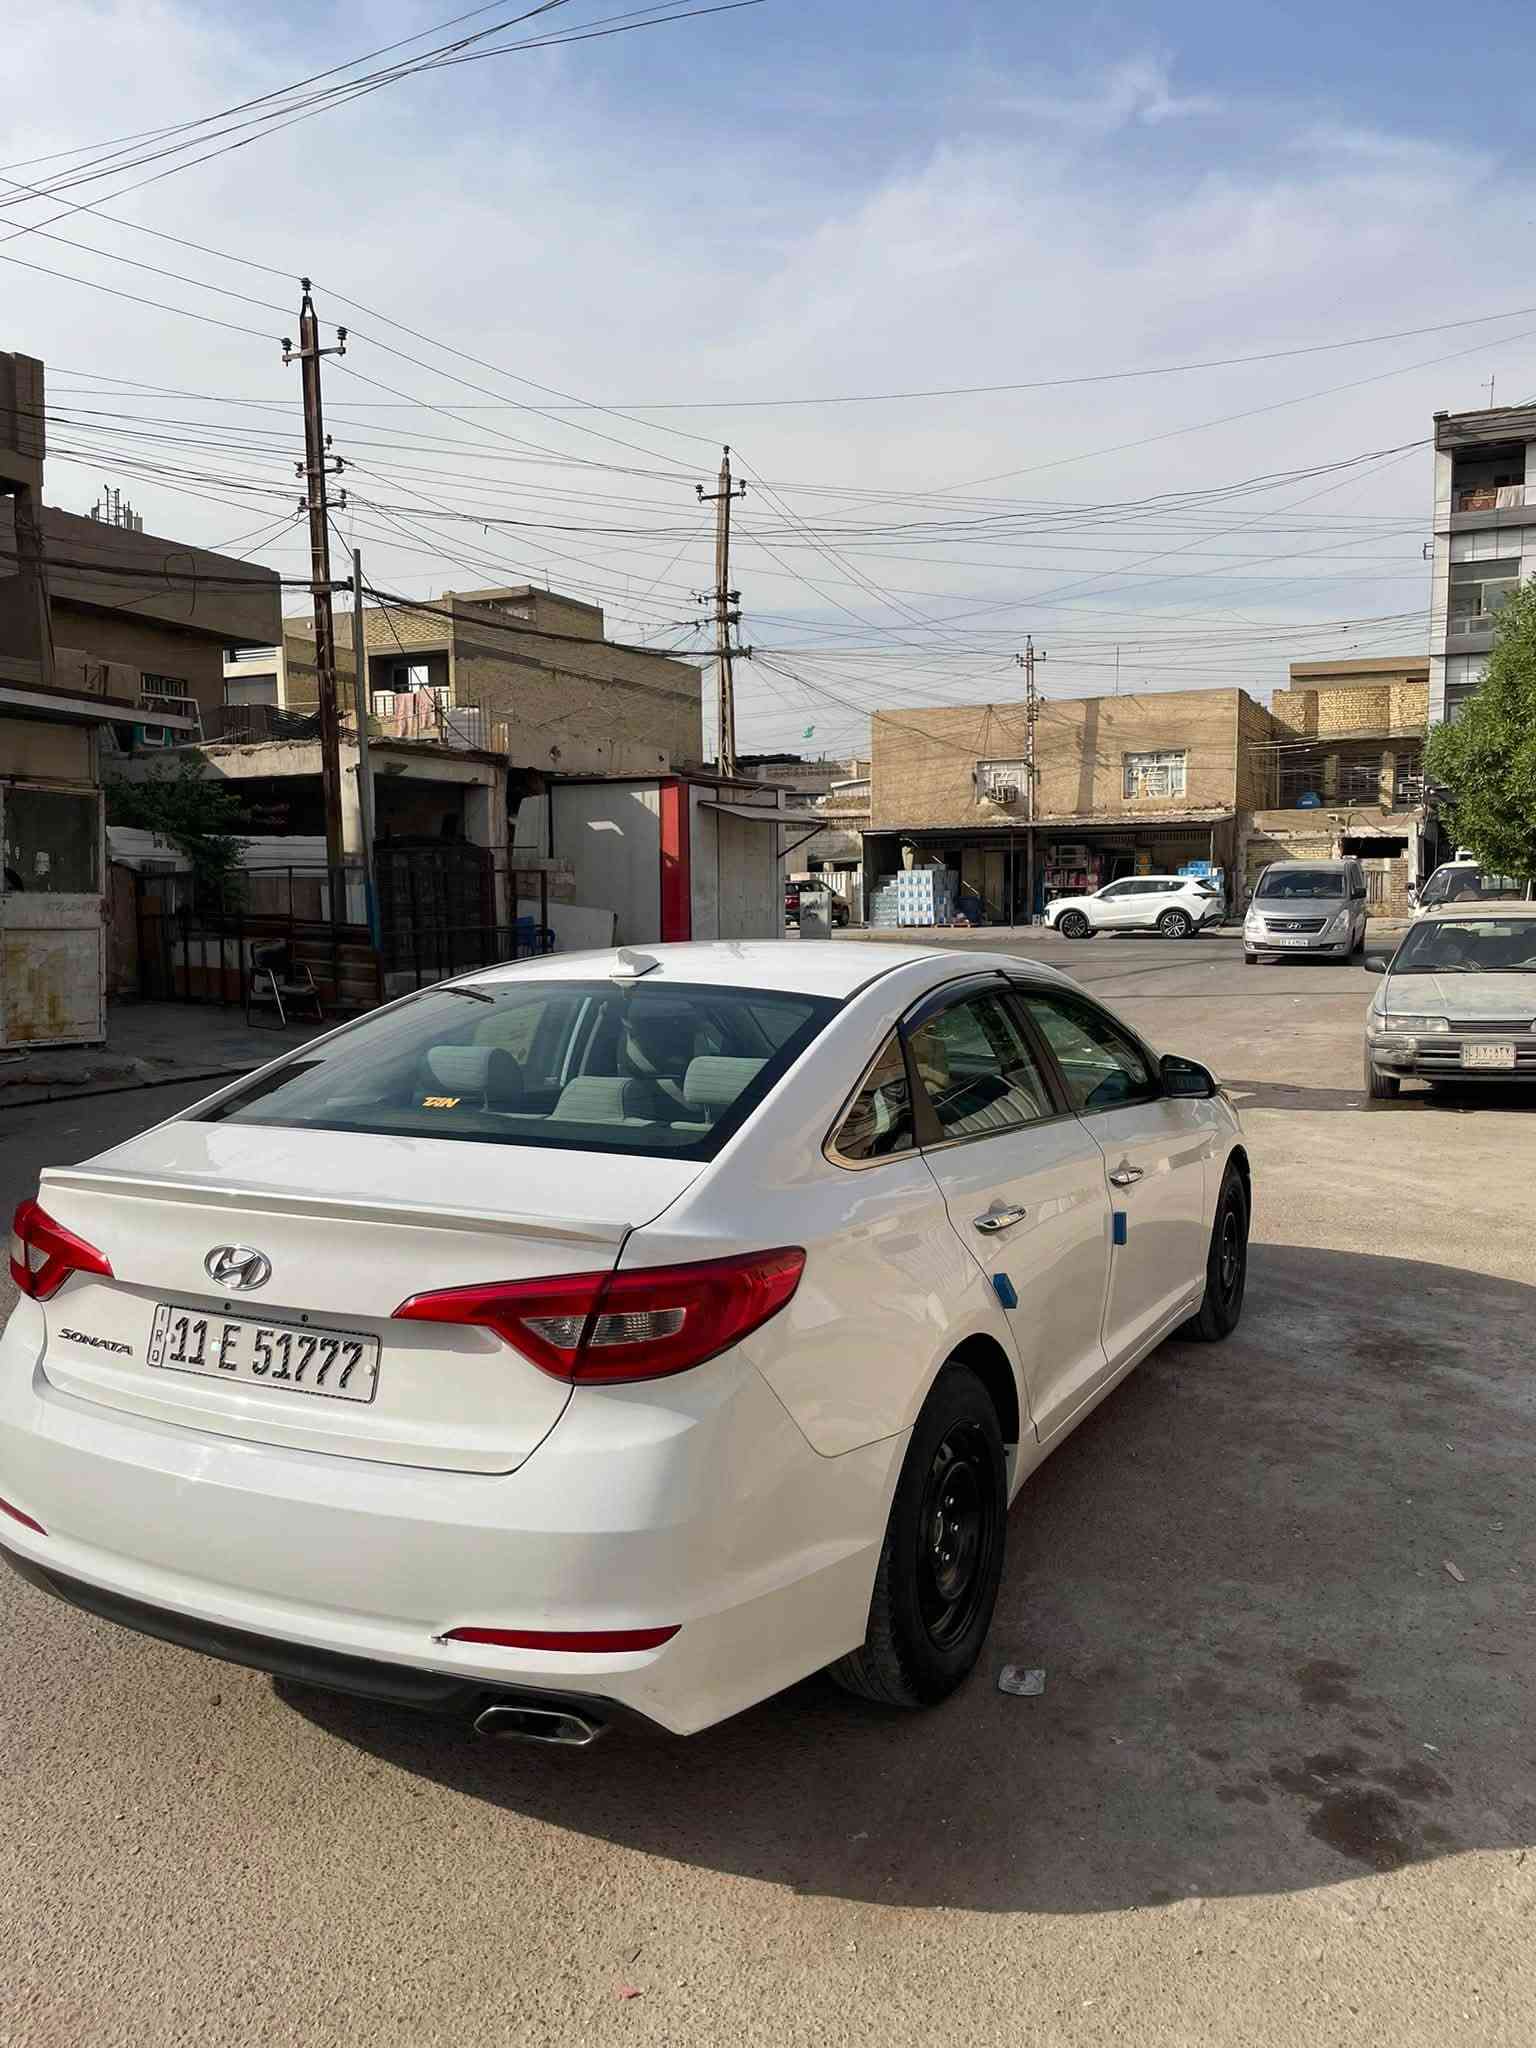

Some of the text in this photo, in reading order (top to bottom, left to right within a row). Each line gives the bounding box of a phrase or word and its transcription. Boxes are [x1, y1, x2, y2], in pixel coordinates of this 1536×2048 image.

[58, 1328, 134, 1356] SONATA
[169, 1316, 363, 1389] 11 E 51777
